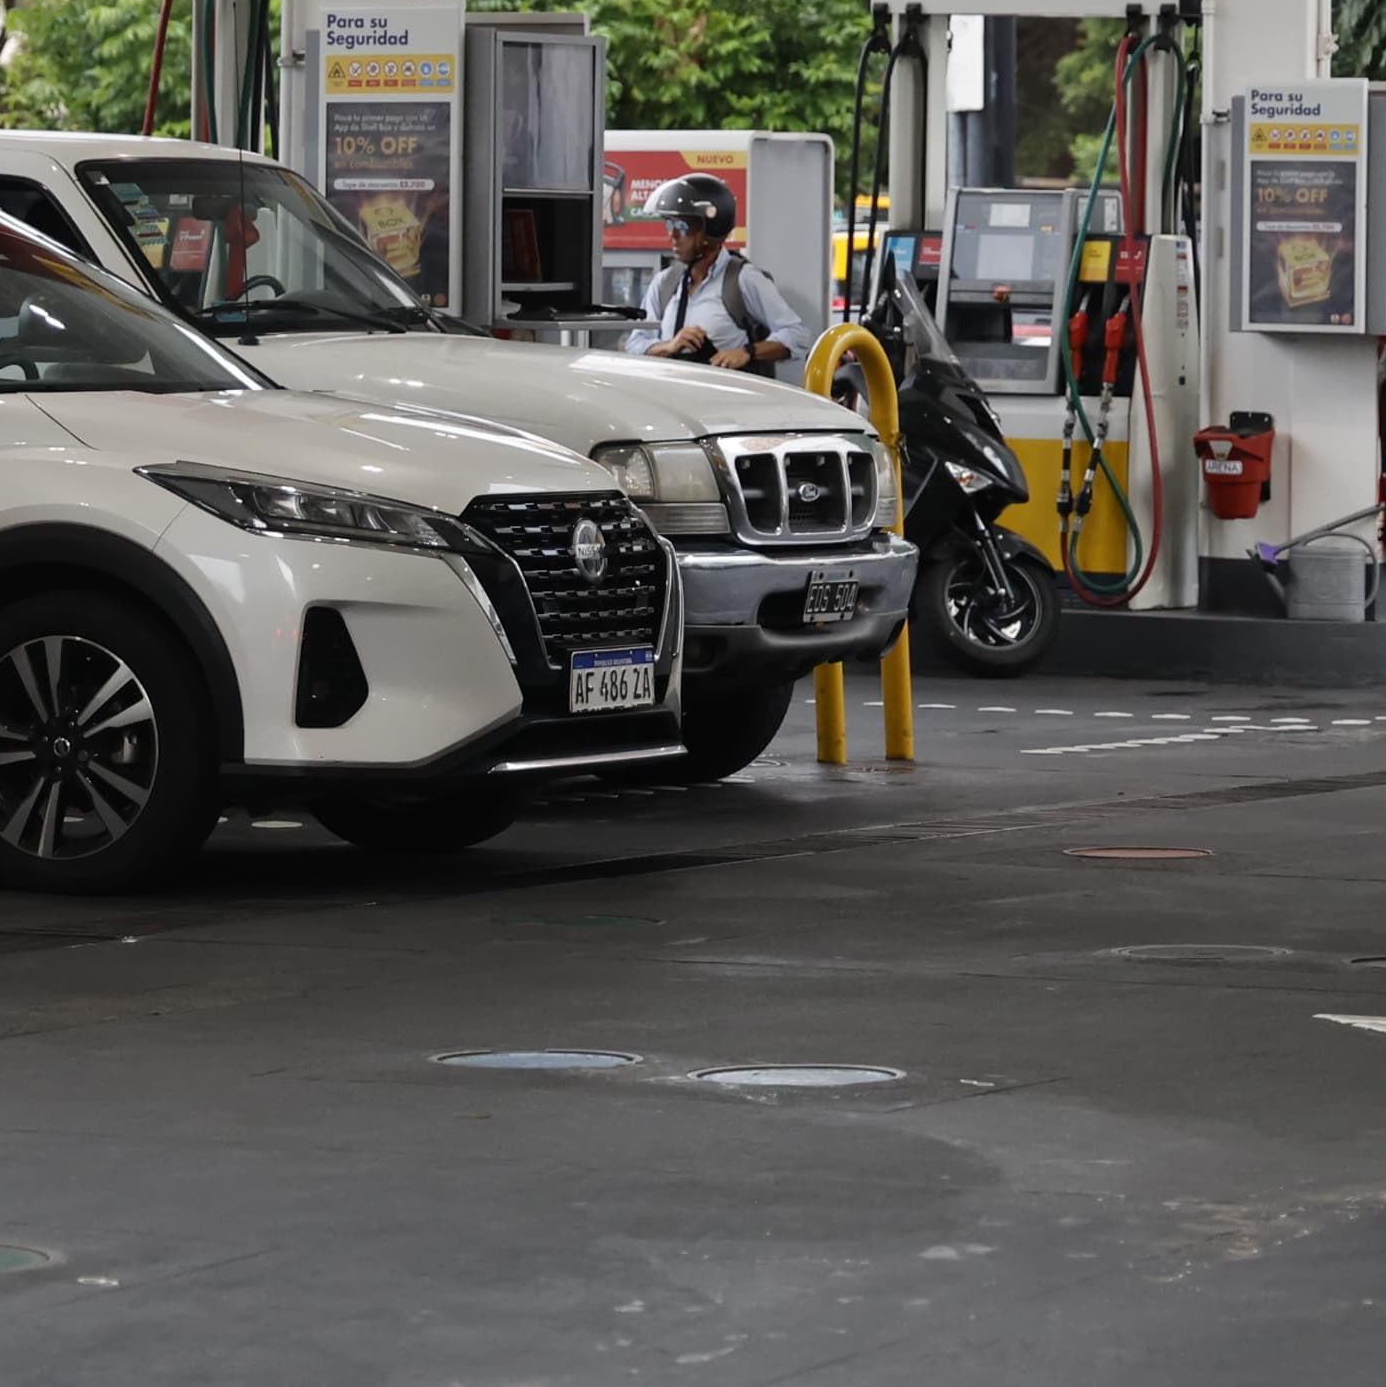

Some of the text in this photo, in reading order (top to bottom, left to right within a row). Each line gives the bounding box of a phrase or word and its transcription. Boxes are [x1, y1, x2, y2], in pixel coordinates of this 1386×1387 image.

[327, 14, 388, 29] Para su
[326, 30, 409, 49] Seguridad
[1251, 89, 1303, 102] Para su
[1251, 104, 1321, 119] Seguridad
[334, 135, 419, 155] 10% OFF
[1295, 187, 1329, 203] OFF
[1207, 462, 1239, 472] ARENA
[575, 671, 595, 704] AF
[600, 668, 629, 702] 486
